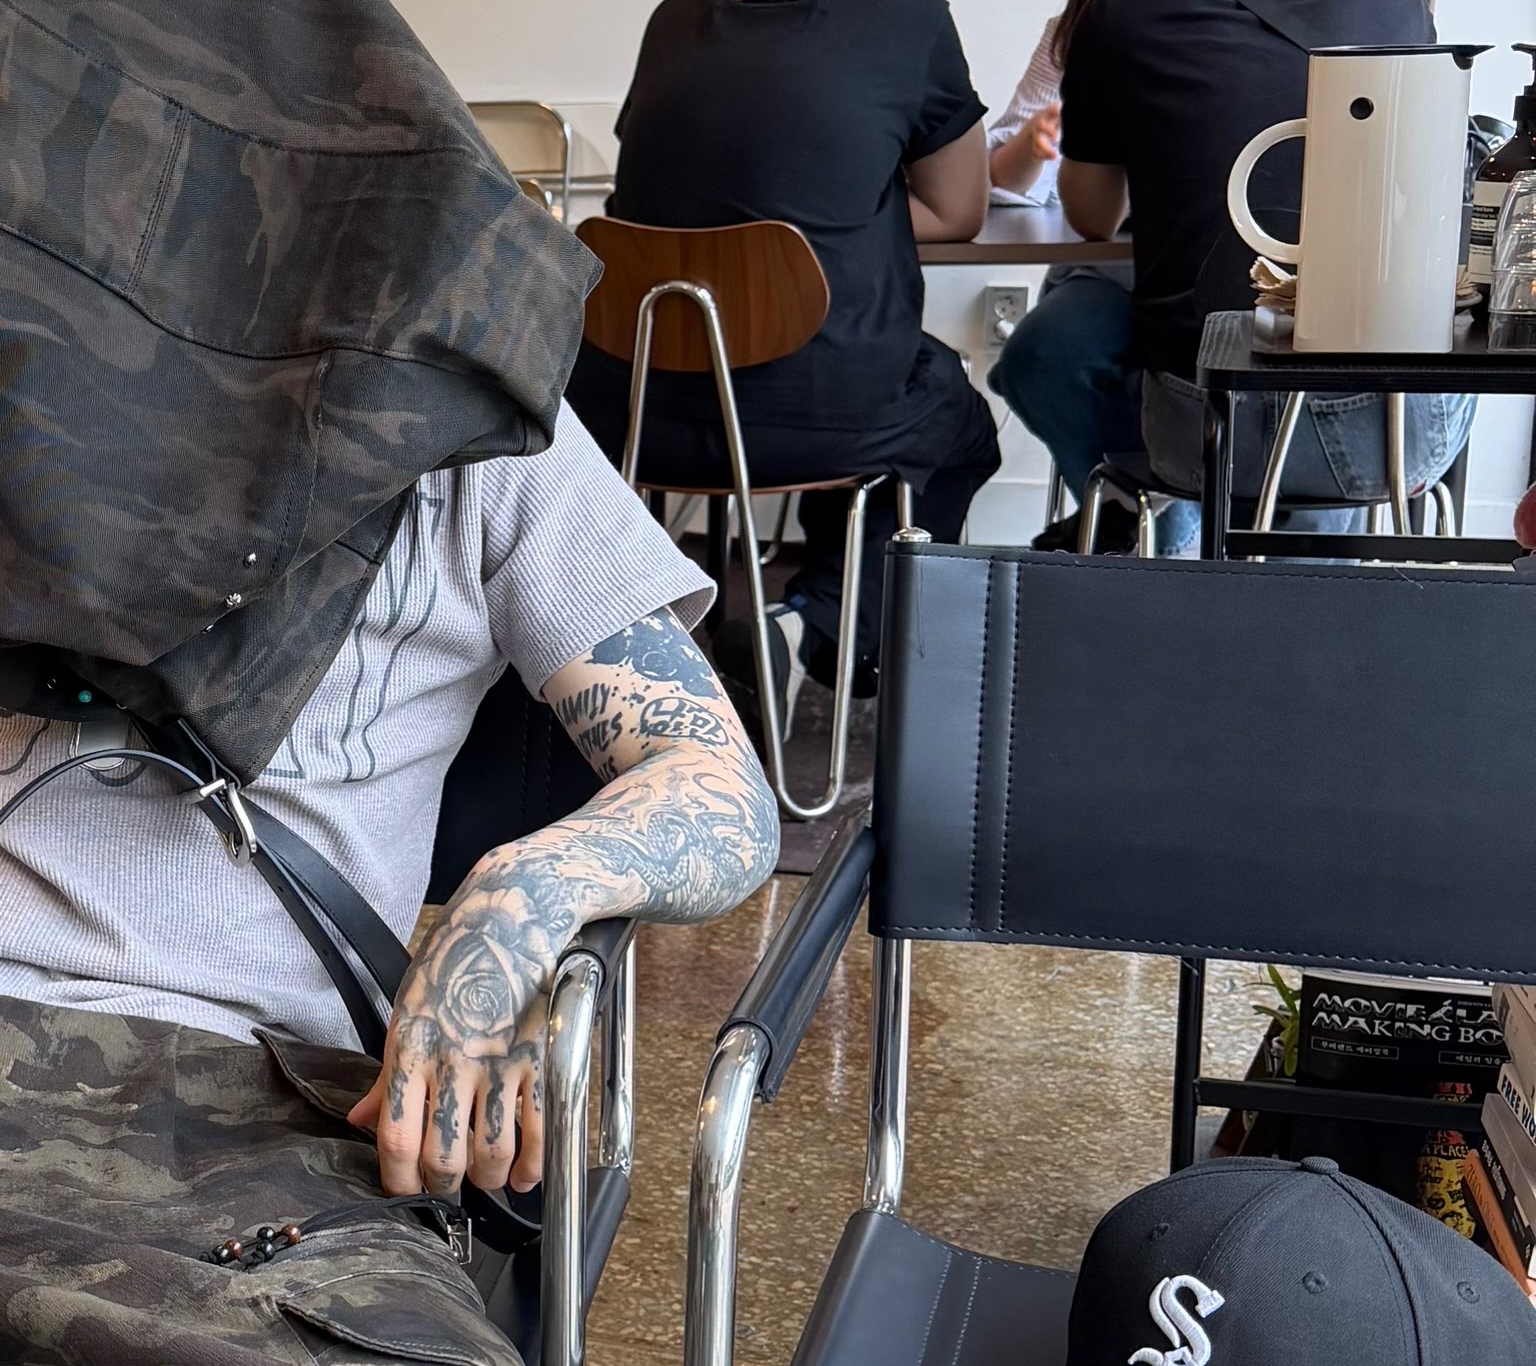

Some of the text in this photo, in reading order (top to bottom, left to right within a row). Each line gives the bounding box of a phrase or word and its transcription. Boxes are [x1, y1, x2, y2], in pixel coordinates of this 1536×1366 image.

[1312, 992, 1427, 1022] MOVIE
[1311, 1011, 1451, 1042] MAKING
[1501, 1073, 1521, 1114] FREE
[1433, 1145, 1470, 1158] PLACE
